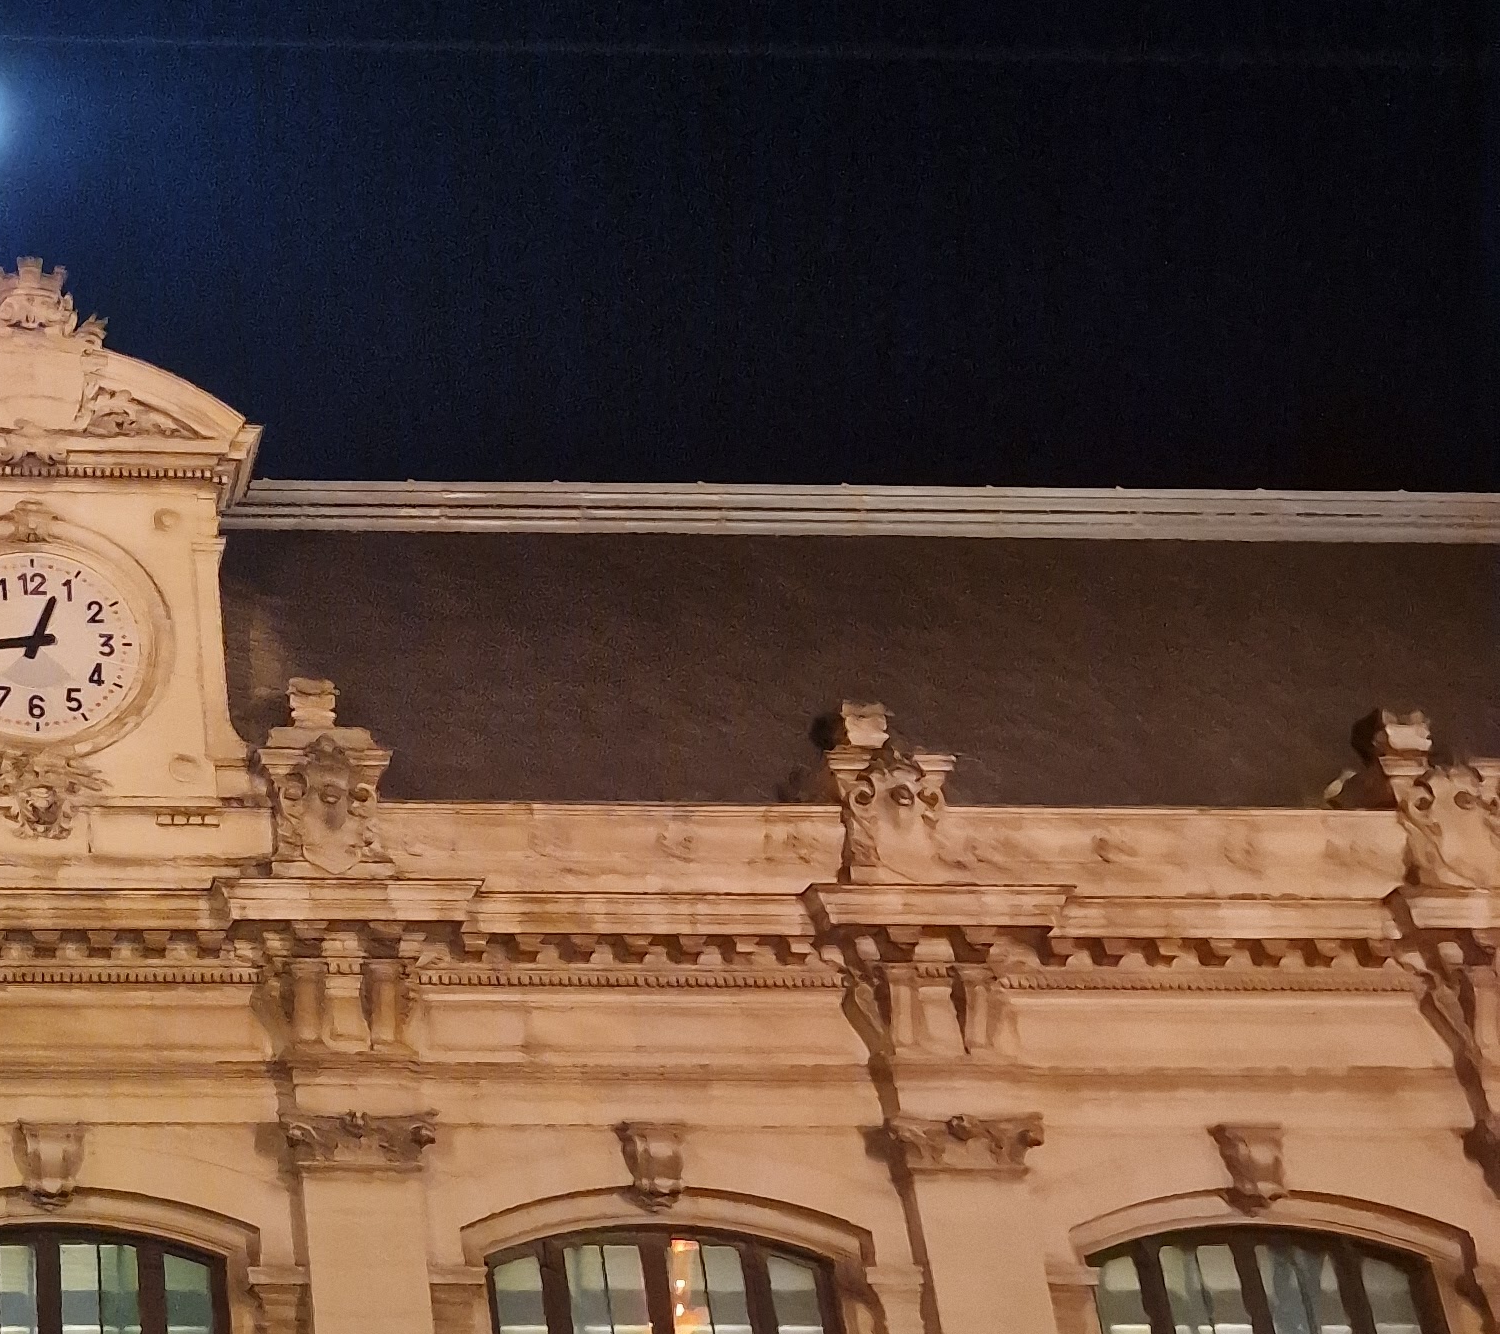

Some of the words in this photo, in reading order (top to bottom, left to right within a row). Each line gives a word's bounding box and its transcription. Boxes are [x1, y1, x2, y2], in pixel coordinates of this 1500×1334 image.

[17, 572, 47, 596] 12
[61, 578, 73, 602] 1
[86, 601, 105, 624] 2
[98, 633, 116, 657] 3
[88, 662, 105, 686] 4
[28, 694, 46, 719] 6
[65, 687, 83, 712] 5
